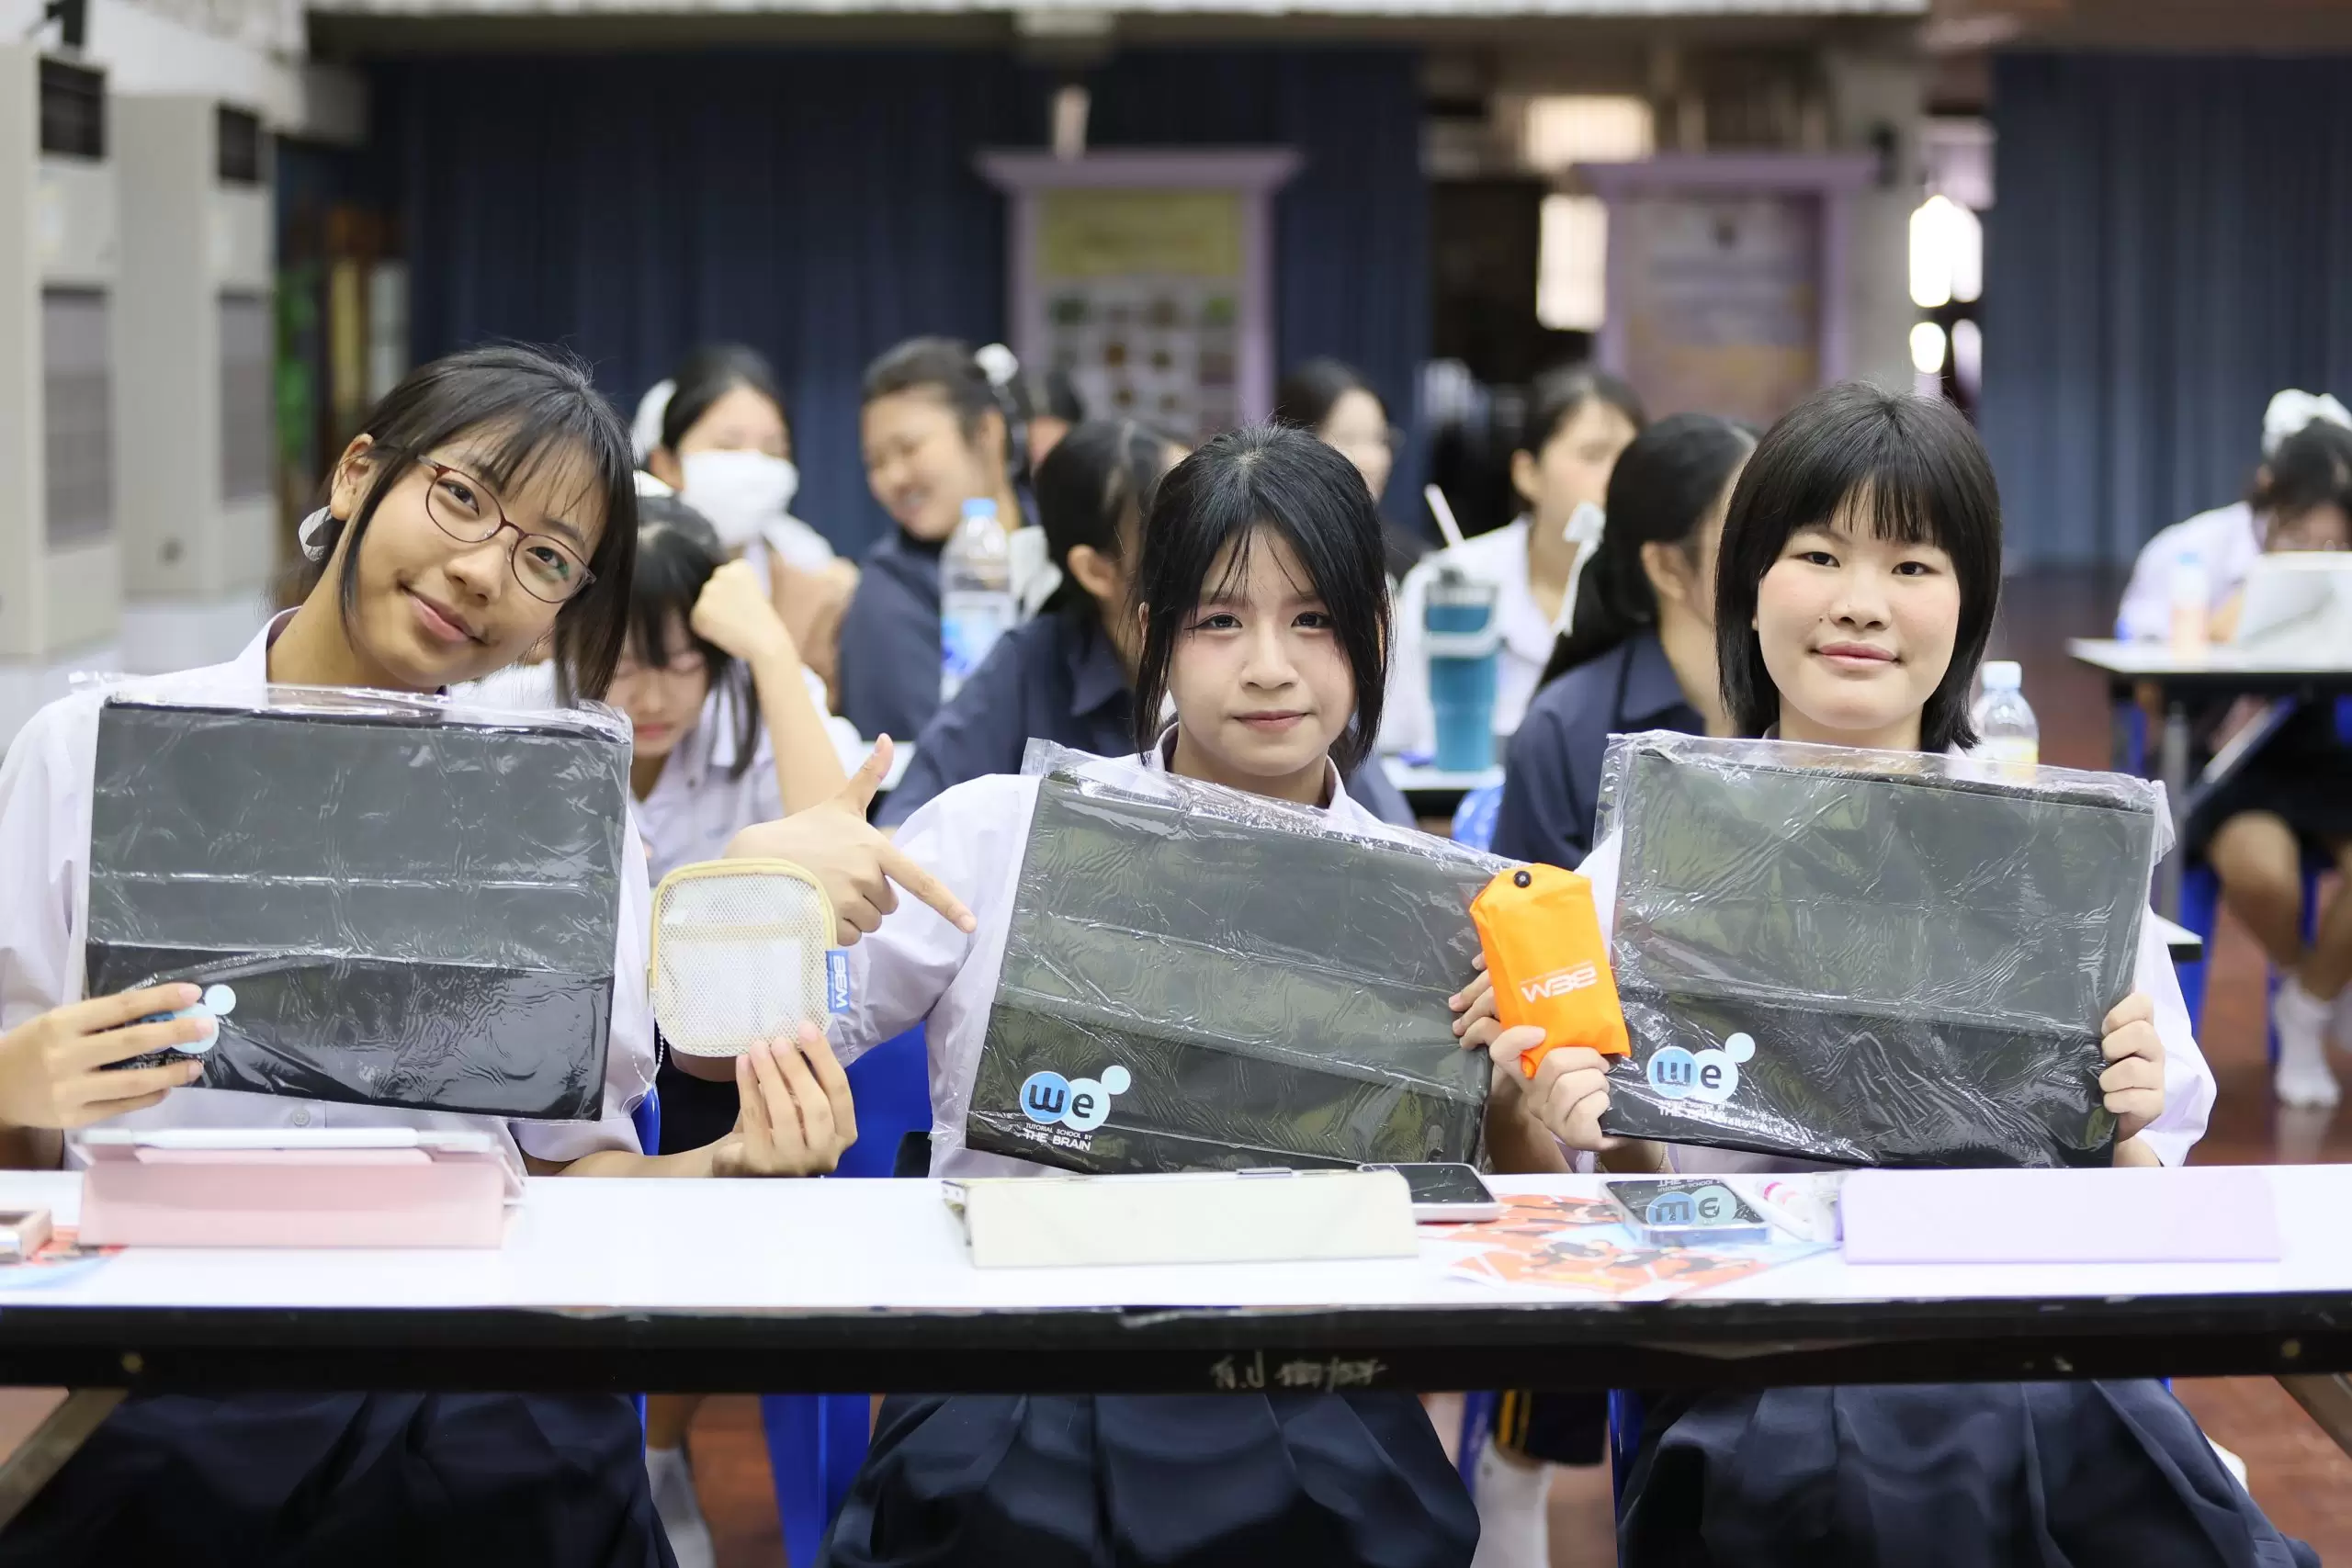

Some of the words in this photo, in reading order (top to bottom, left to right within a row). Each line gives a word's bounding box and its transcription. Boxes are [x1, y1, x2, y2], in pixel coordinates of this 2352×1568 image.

[1657, 1061, 1722, 1089] we
[1029, 1084, 1094, 1119] we
[1023, 1128, 1049, 1144] THE
[1052, 1134, 1091, 1152] BRAIN
[1025, 1122, 1054, 1134] TUTORIAL
[1056, 1128, 1081, 1139] SCHOOL
